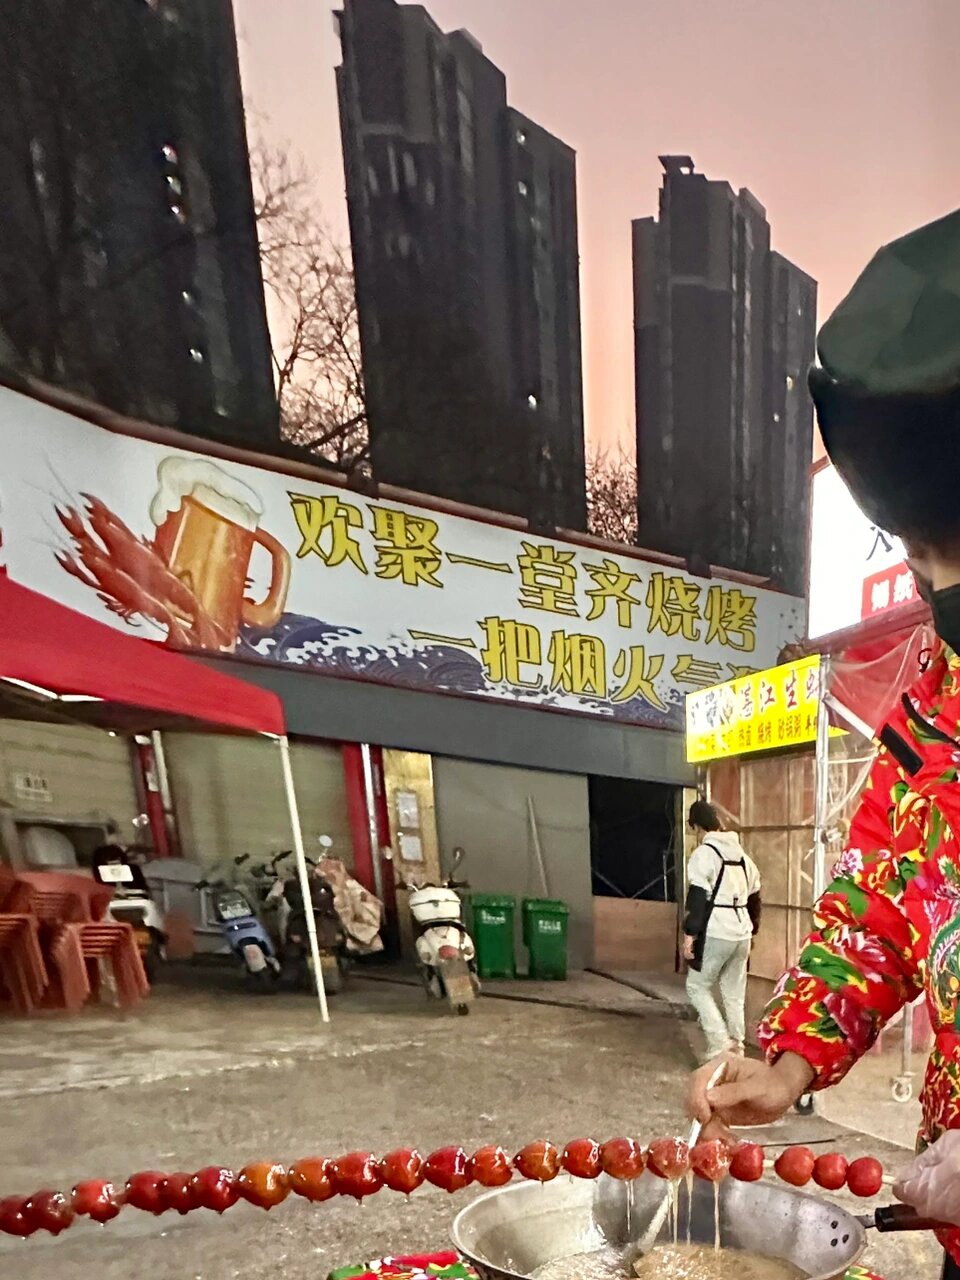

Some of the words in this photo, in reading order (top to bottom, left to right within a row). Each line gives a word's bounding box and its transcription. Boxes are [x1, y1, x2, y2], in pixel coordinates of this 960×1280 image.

[287, 490, 758, 652] 欢聚一堂齐烧烤
[408, 616, 763, 713] 一把烟火气
